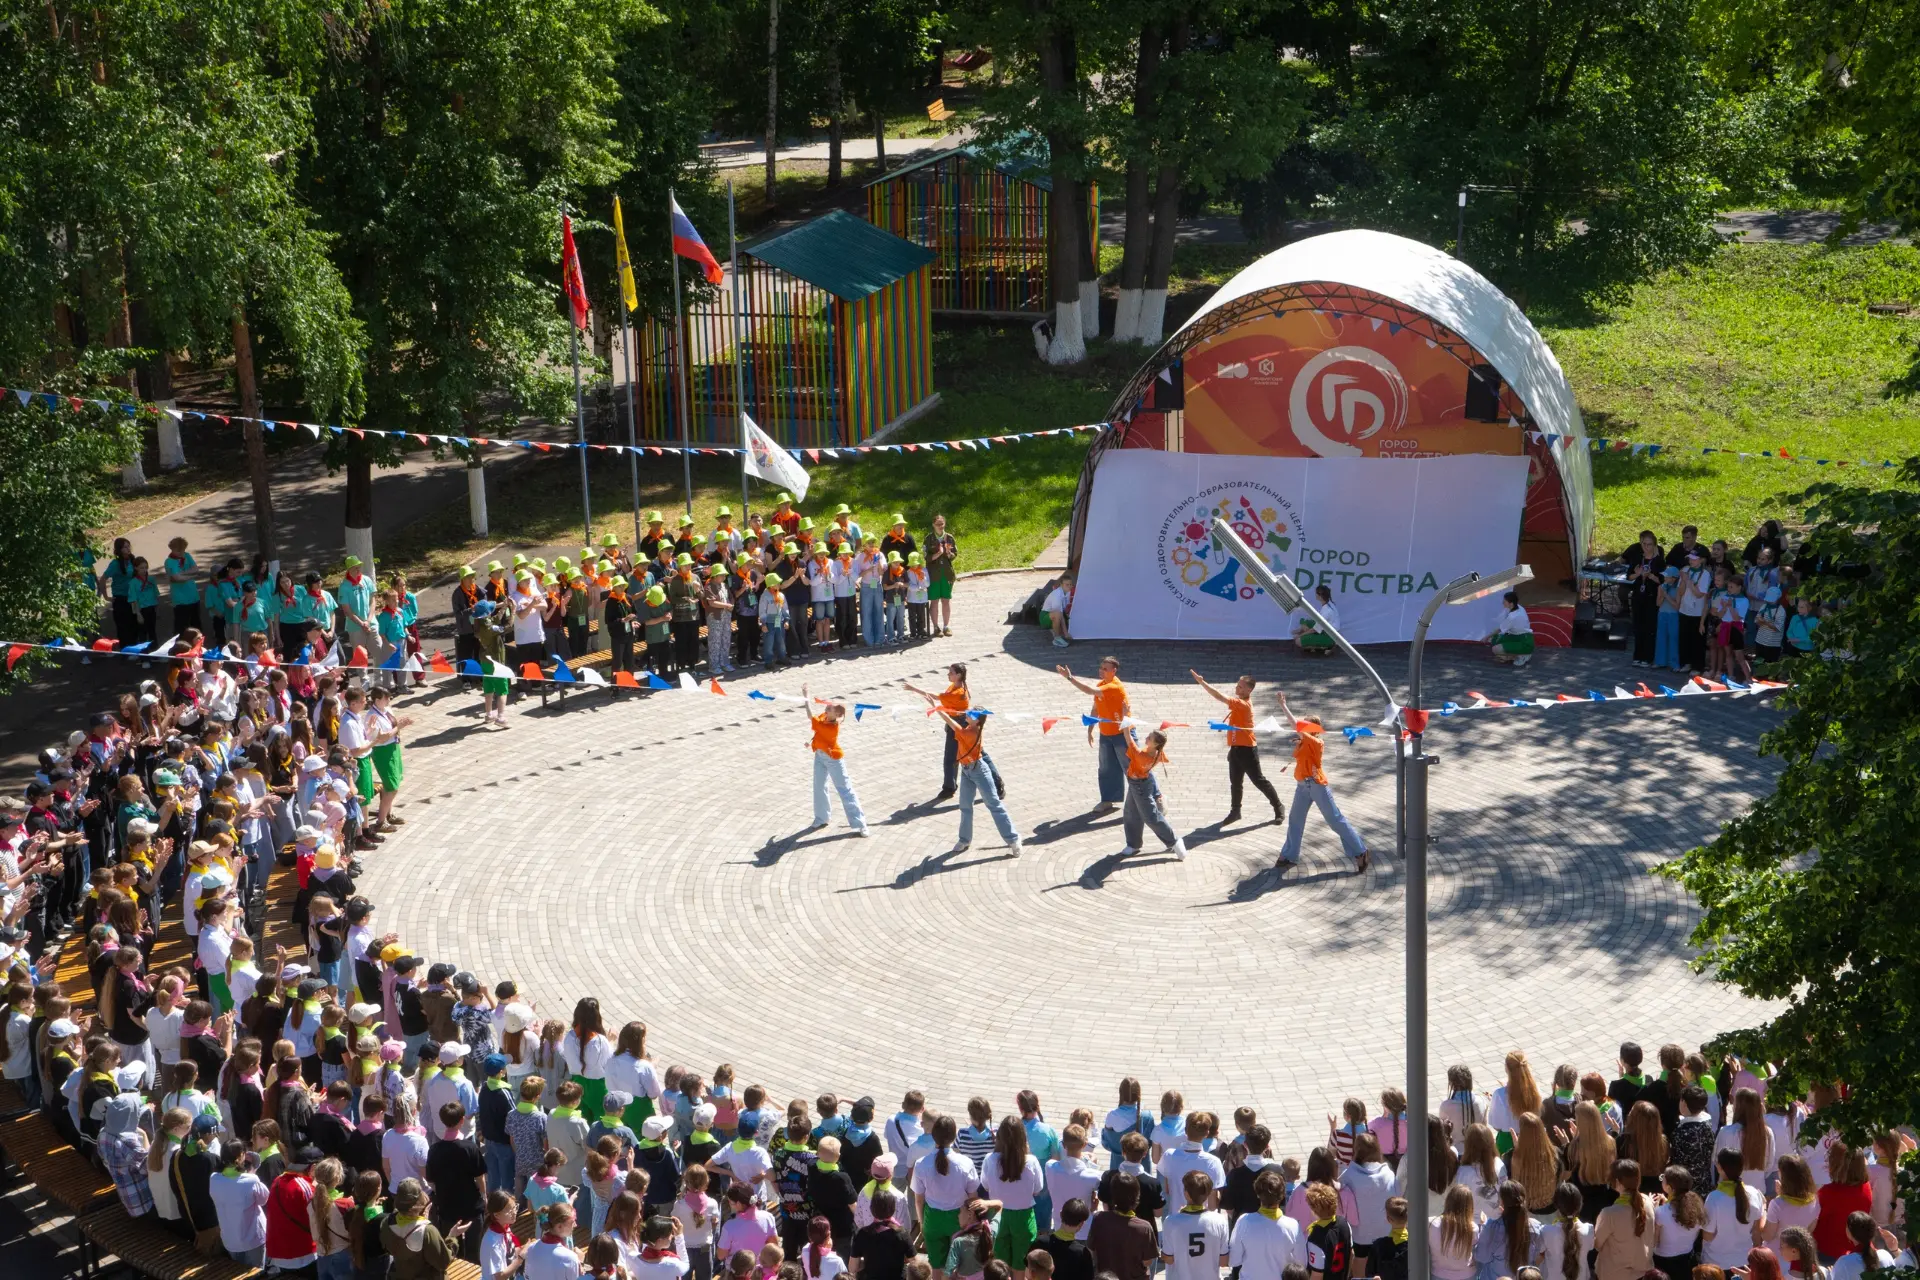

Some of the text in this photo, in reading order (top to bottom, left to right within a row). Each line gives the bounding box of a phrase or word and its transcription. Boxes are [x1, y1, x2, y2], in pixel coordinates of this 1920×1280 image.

[1163, 577, 1199, 608] ДЕТСКИЙ
[1289, 512, 1306, 543] ЦЕНТР
[1189, 1233, 1205, 1257] 5
[1309, 1251, 1316, 1265] 5
